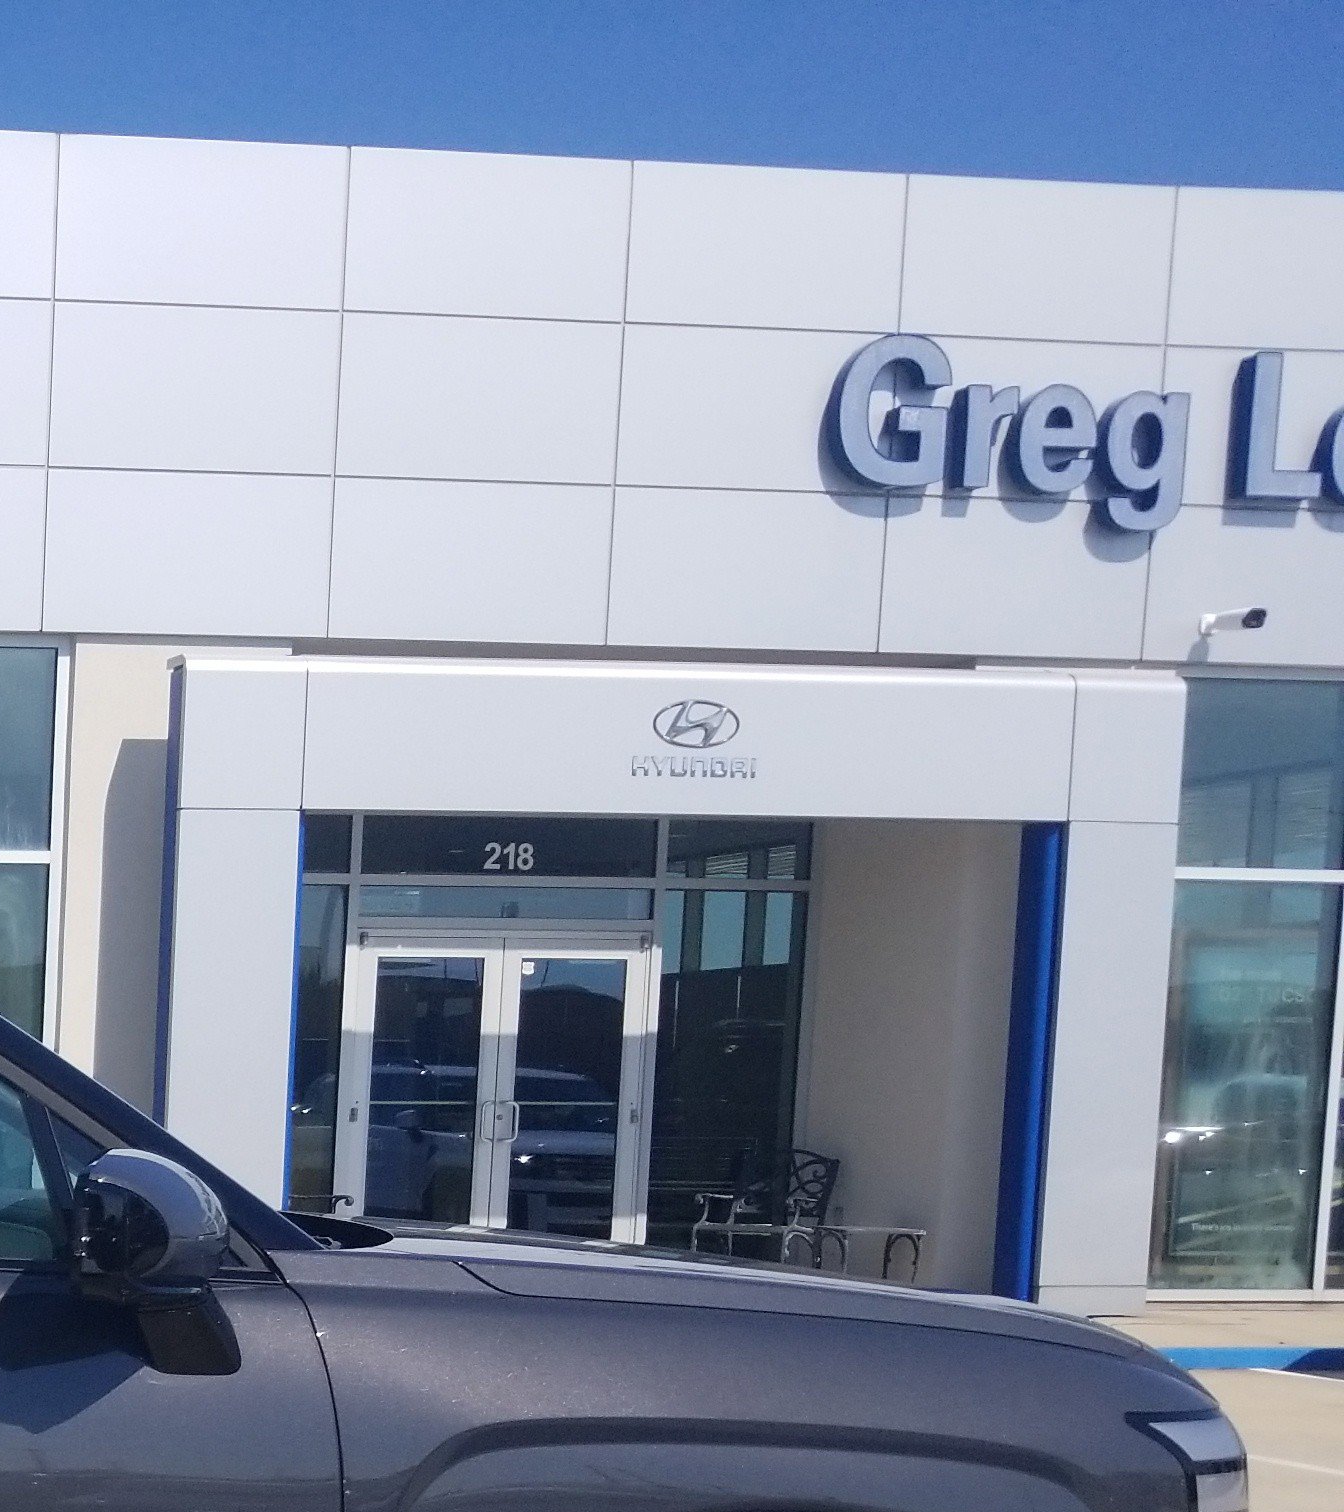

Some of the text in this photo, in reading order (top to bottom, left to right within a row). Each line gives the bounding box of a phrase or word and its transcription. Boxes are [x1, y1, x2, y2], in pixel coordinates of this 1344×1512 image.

[819, 333, 1344, 532] Greg L
[631, 755, 757, 779] HYUNDAI
[483, 842, 534, 871] 218
